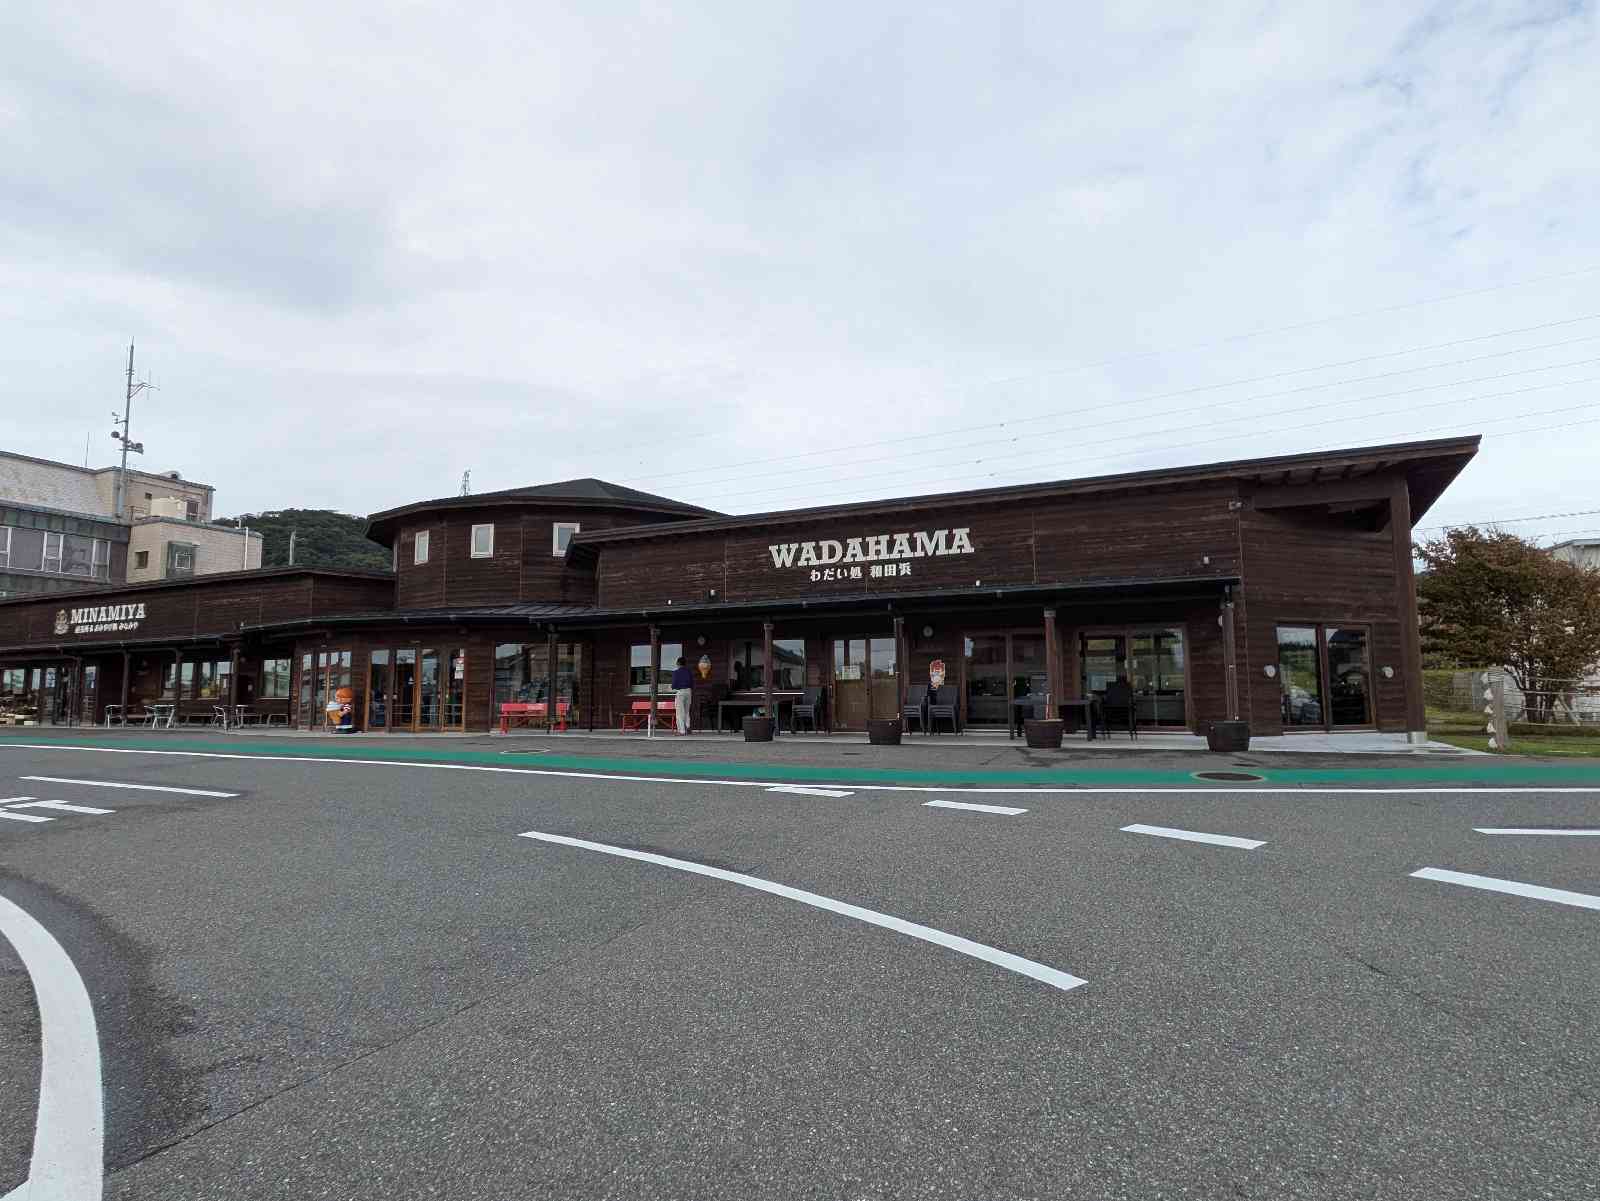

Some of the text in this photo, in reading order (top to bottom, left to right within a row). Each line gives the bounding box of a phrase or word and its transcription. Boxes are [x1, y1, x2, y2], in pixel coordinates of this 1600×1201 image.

[768, 528, 975, 569] WADAHAMA
[809, 562, 912, 582] わだい処 和田浜
[70, 603, 146, 624] MINAMIYA
